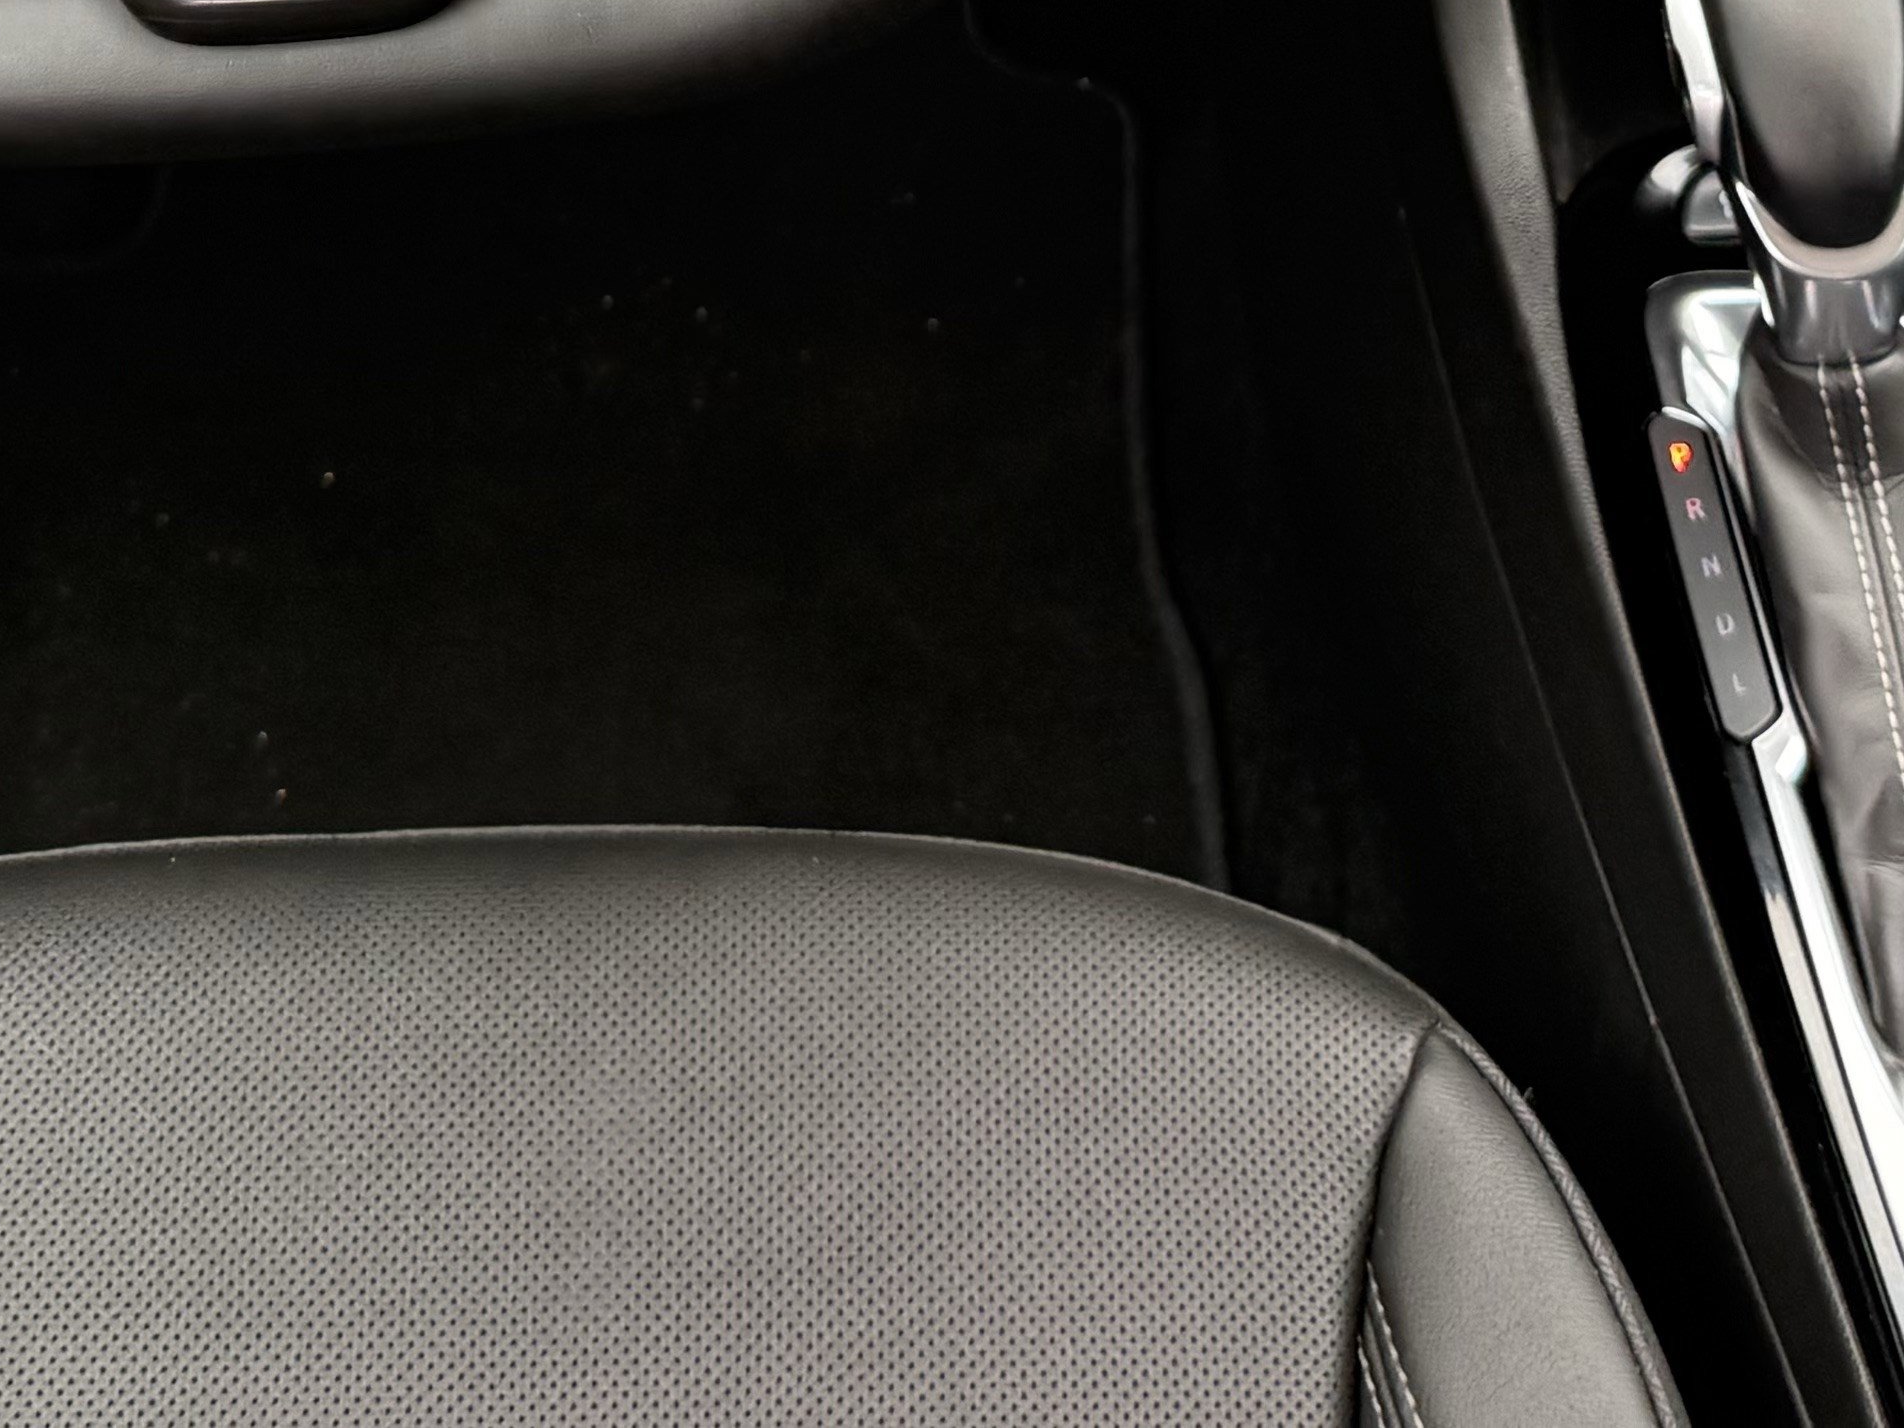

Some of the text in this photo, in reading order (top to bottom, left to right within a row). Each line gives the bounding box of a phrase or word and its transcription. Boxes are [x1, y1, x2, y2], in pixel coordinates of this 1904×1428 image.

[1669, 443, 1693, 473] P
[1686, 498, 1706, 520] R
[1701, 555, 1721, 577] N
[1732, 672, 1746, 694] L
